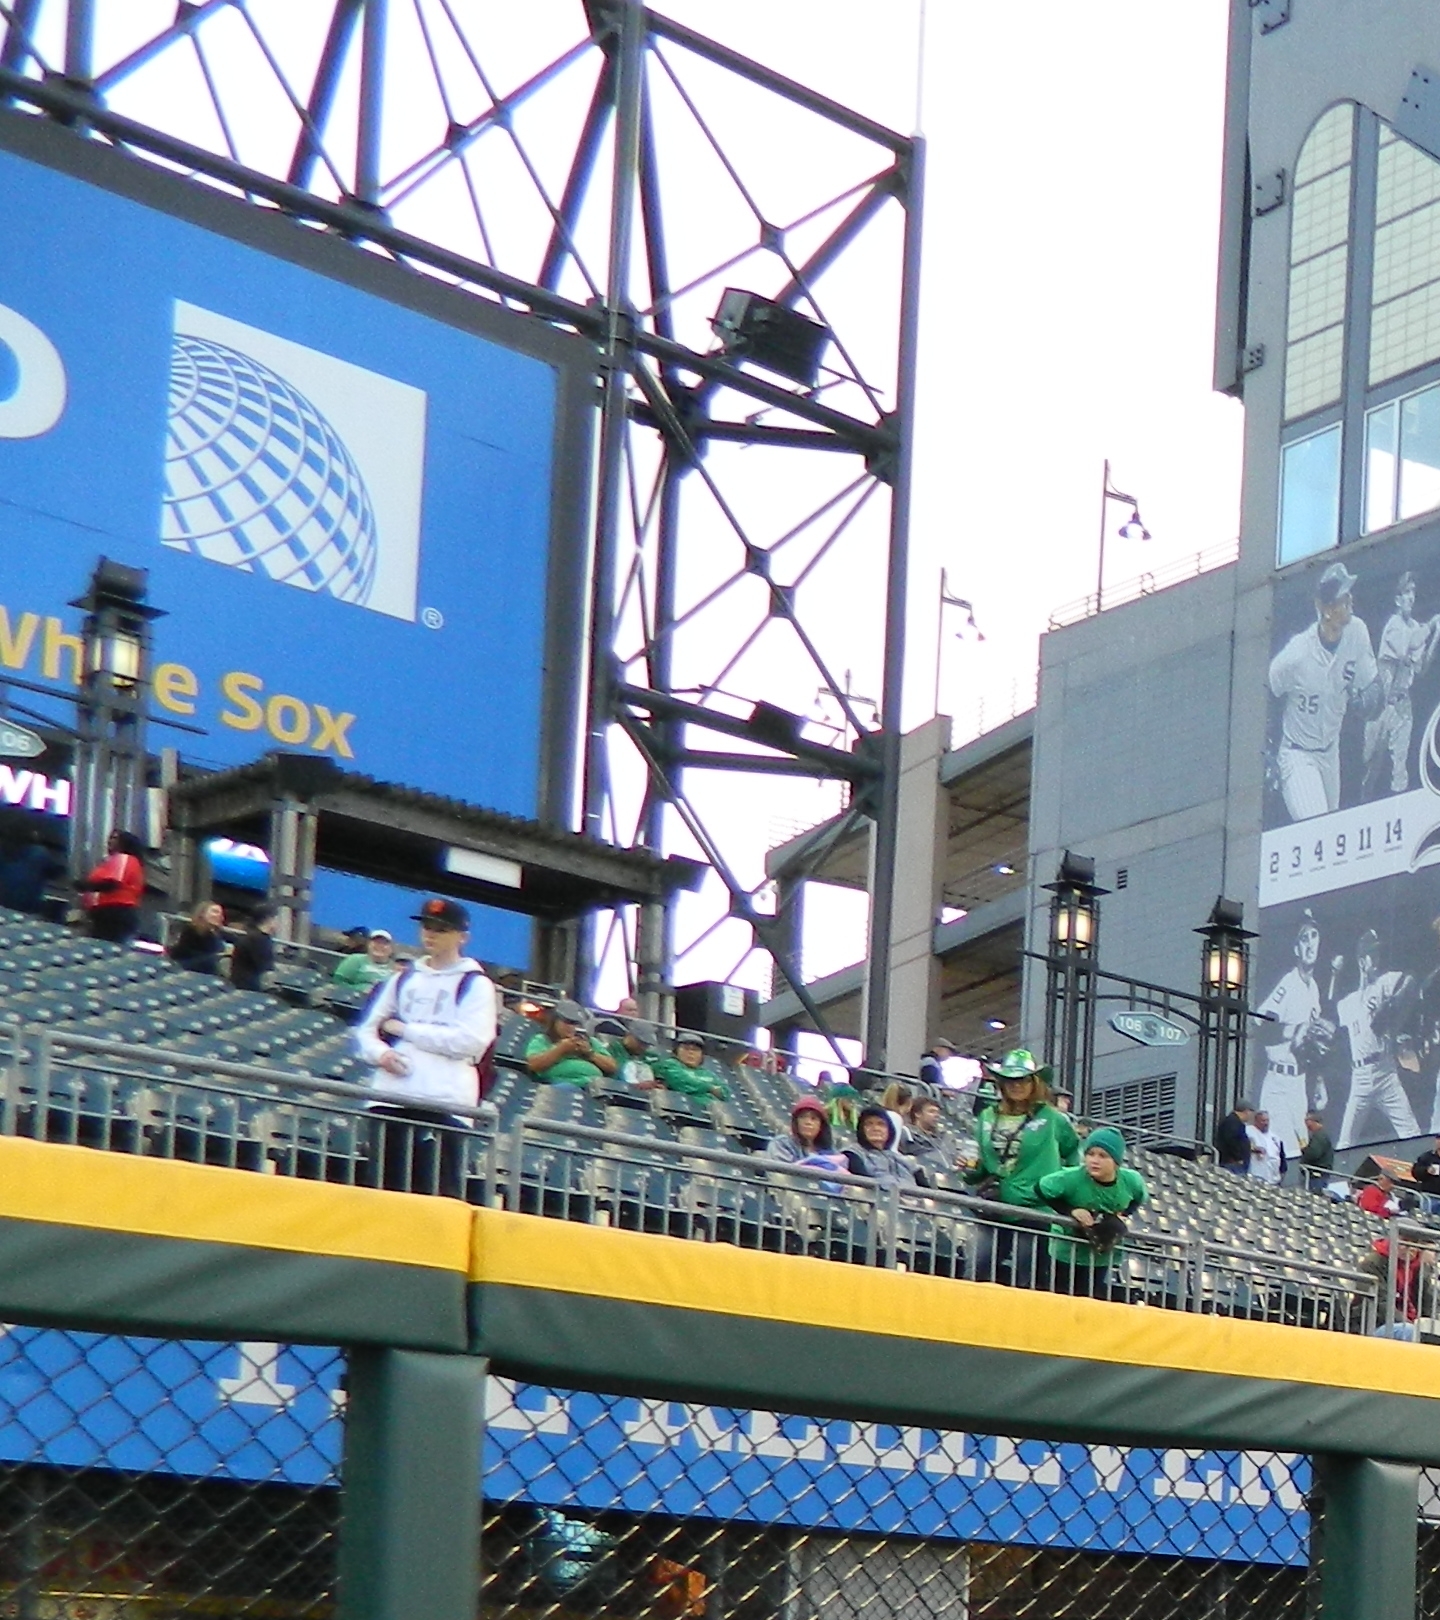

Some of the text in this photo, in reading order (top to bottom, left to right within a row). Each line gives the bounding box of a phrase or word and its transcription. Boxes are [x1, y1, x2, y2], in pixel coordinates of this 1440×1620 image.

[220, 671, 356, 759] Sox
[1269, 818, 1402, 874] 2 3 4 9 11 14
[1119, 1016, 1142, 1032] 106
[1160, 1026, 1182, 1041] 107
